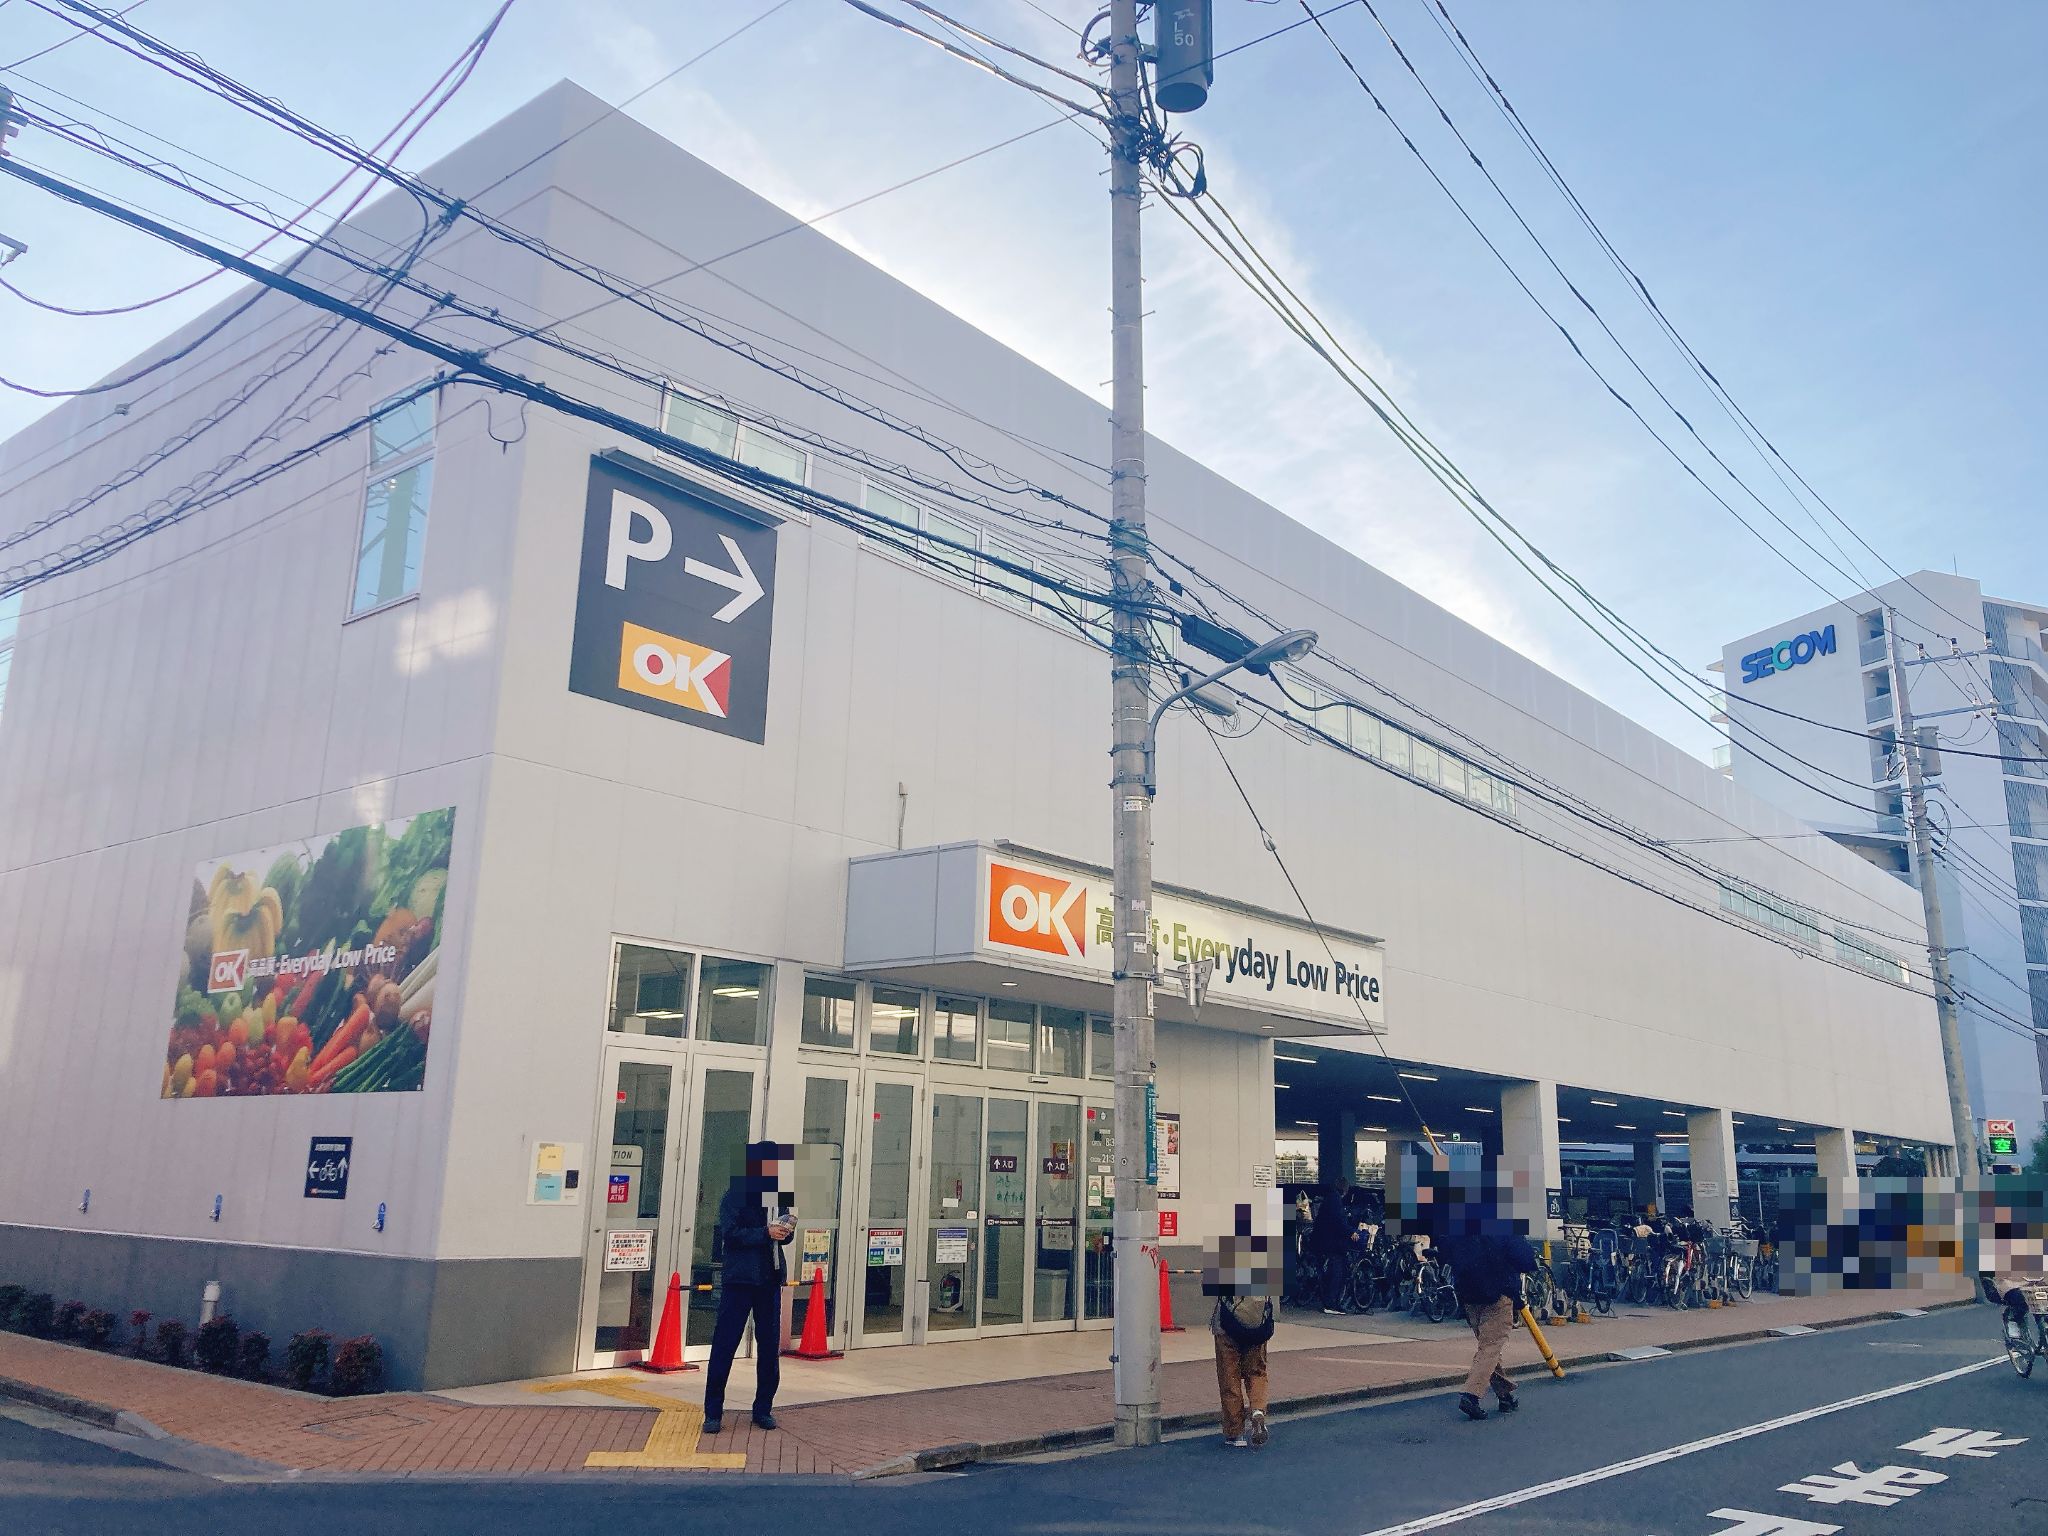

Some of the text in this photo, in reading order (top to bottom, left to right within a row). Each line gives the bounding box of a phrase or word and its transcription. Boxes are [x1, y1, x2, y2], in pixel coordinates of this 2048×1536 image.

[1174, 33, 1194, 46] 50
[605, 489, 674, 591] P
[632, 642, 732, 718] OK
[1741, 624, 1837, 684] SECOM
[1000, 881, 1086, 959] OK
[213, 950, 247, 989] OK
[334, 949, 362, 968] Low
[364, 942, 396, 964] Price
[1286, 948, 1329, 992] Low
[1334, 960, 1380, 1003] Price
[1990, 1120, 2015, 1134] OK
